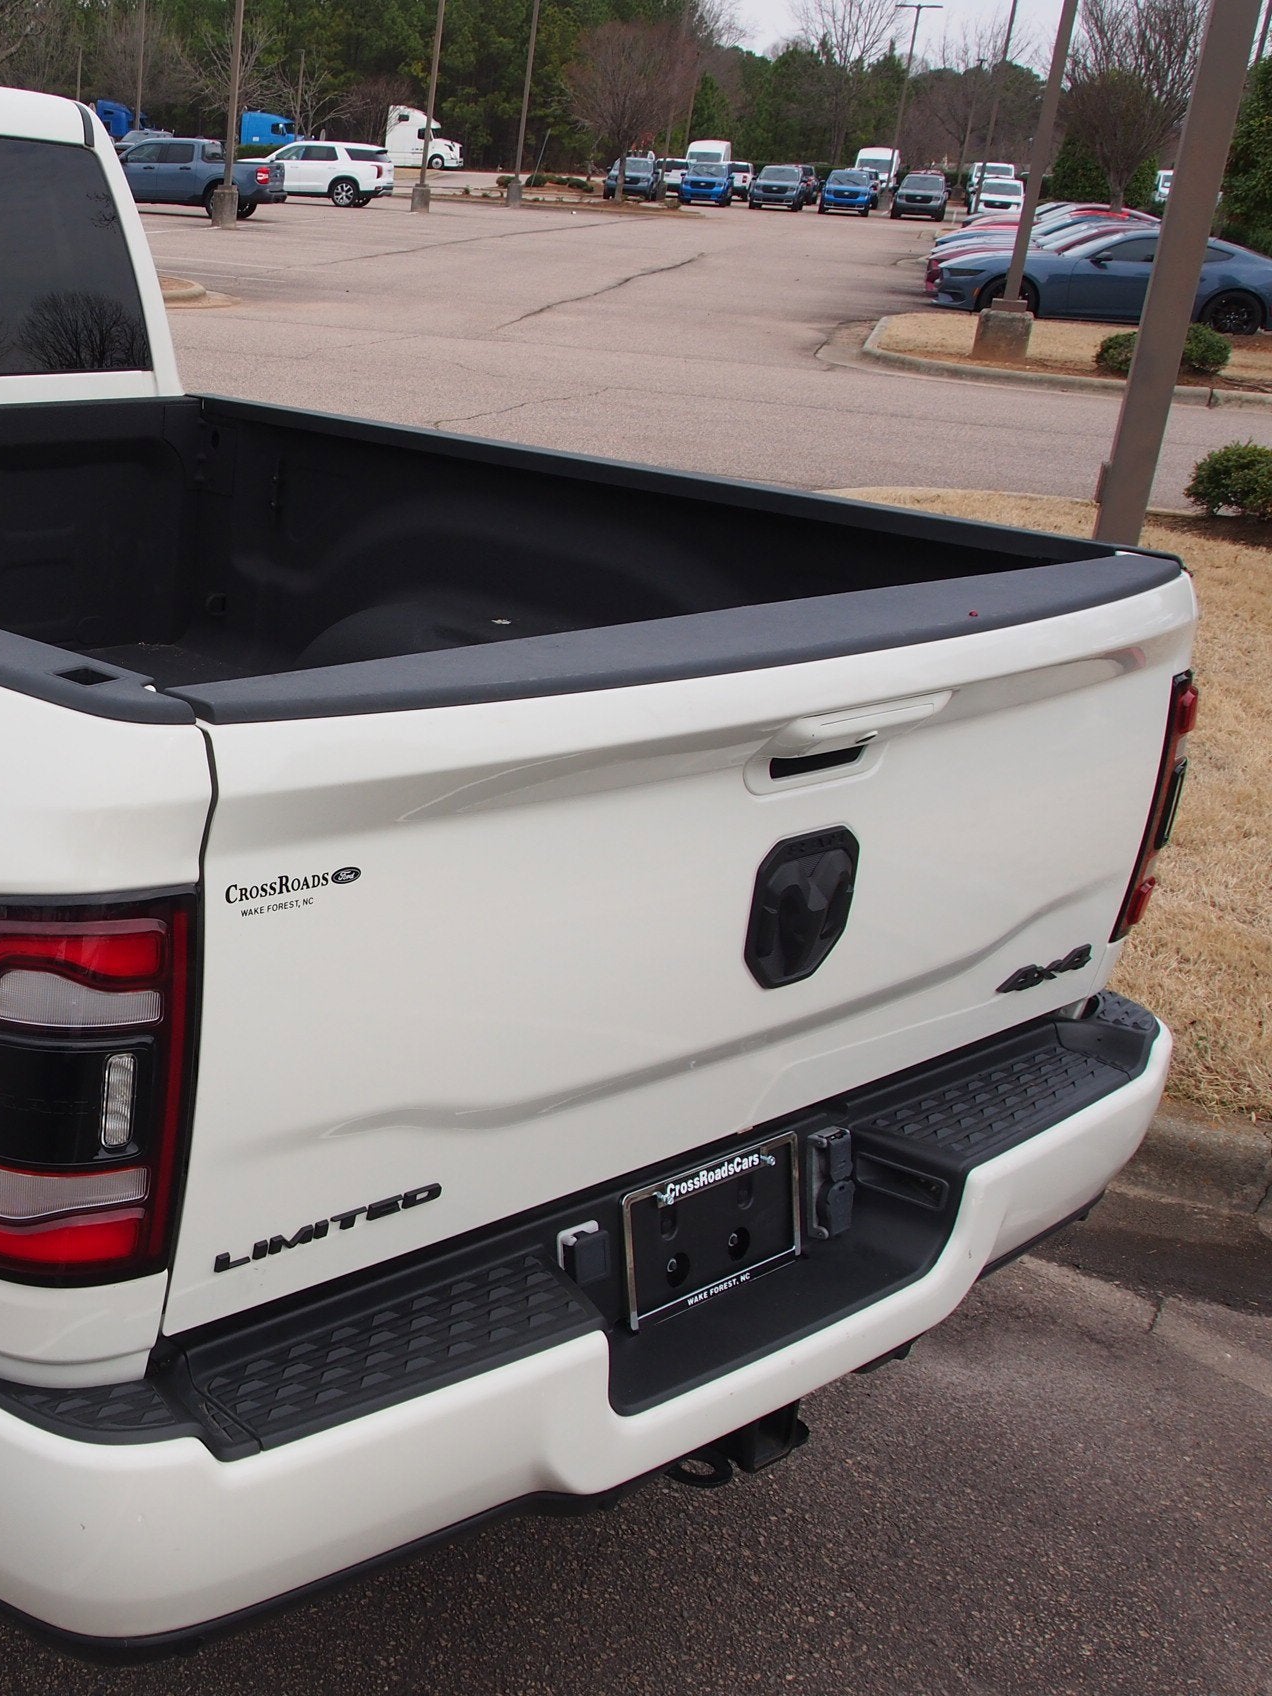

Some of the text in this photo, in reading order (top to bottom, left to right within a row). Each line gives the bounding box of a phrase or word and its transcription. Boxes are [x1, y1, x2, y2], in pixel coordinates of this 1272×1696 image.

[334, 868, 359, 883] Ford
[241, 897, 314, 917] WAKE FOREST, NC
[666, 1153, 760, 1198] CrossRoadsCars
[214, 1182, 442, 1273] LIMITED
[687, 1272, 751, 1306] WAKE FOREST, NC
